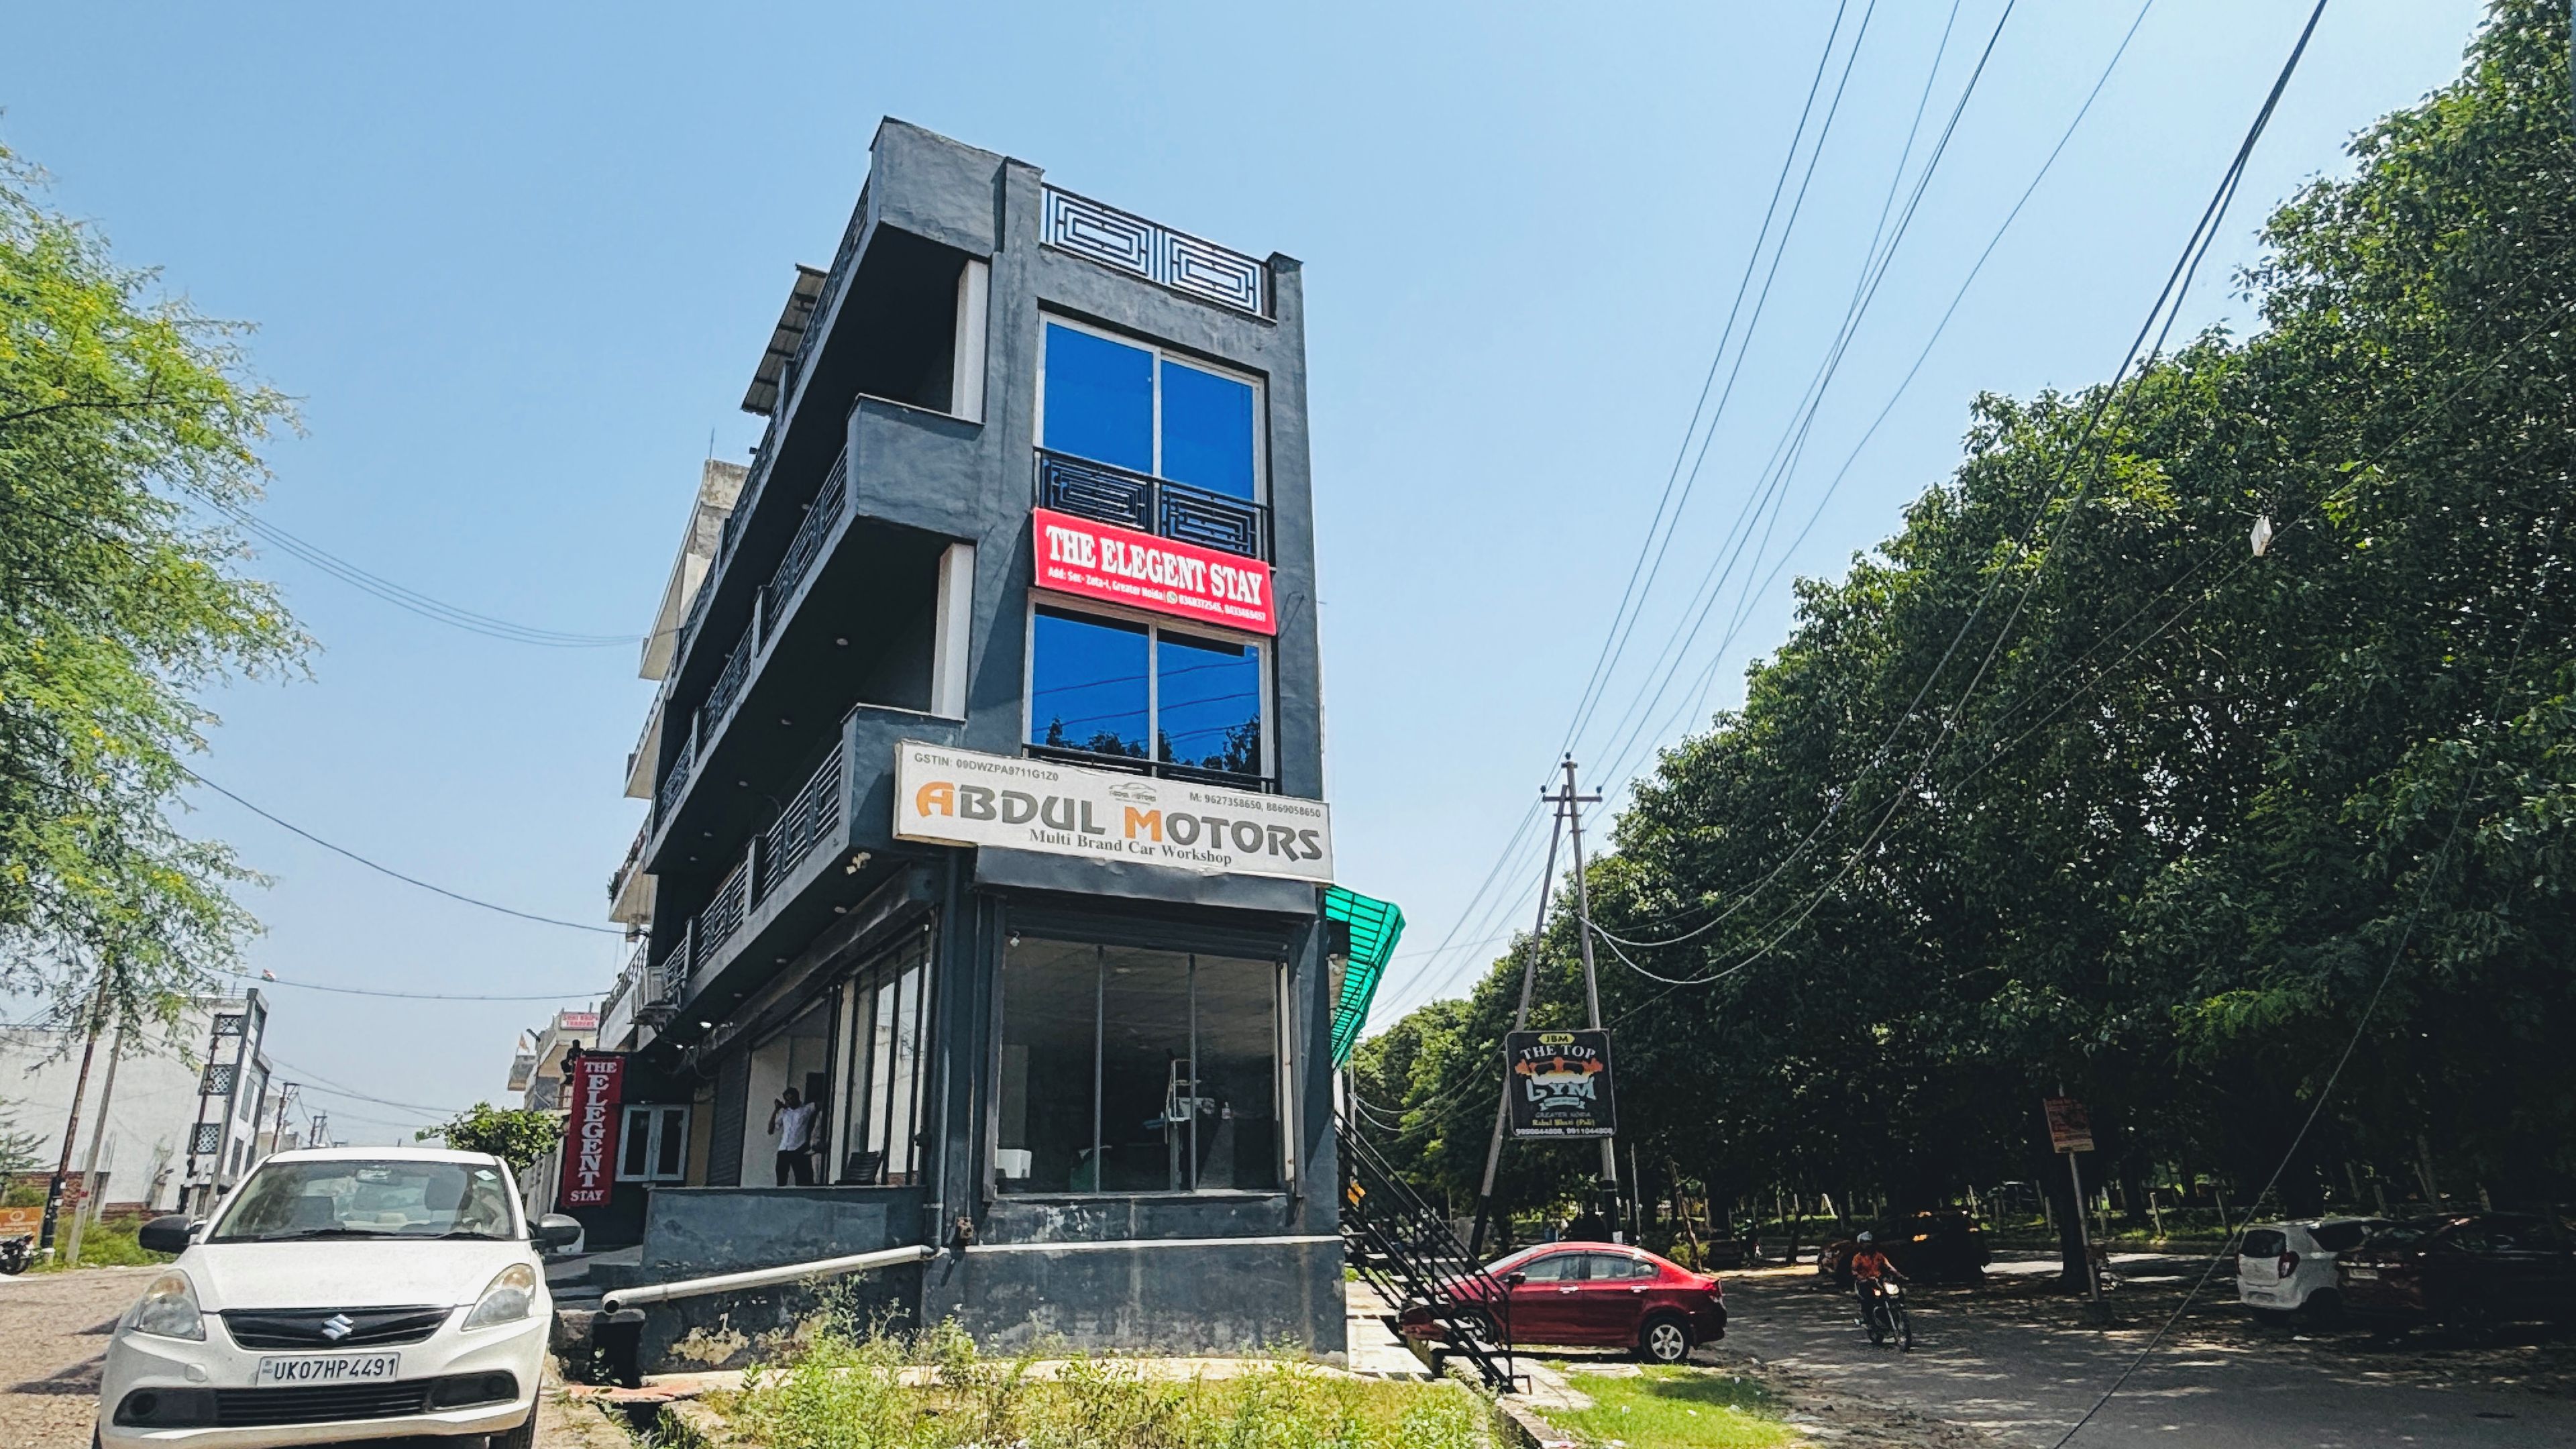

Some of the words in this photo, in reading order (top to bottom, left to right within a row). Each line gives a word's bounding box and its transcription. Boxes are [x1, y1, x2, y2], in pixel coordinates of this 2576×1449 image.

[1045, 525, 1096, 569] THE
[1099, 537, 1207, 594] ELEGENT
[1210, 561, 1263, 606] STAY
[1112, 580, 1140, 595] Greater
[914, 753, 953, 767] GSTIN:
[1189, 792, 1201, 802] M:
[916, 781, 1106, 835] ABDUL
[1124, 806, 1323, 862] MOTORS
[1030, 828, 1071, 846] Multi
[1077, 834, 1122, 853] Brand
[1128, 841, 1156, 856] Car
[1161, 844, 1232, 867] Workshop
[1519, 1045, 1556, 1060] THE
[1560, 1044, 1596, 1059] TOP
[584, 1062, 617, 1073] THE
[1525, 1076, 1597, 1102] GYM
[578, 1075, 610, 1187] ELEGENT
[570, 1190, 604, 1202] STAY
[274, 1358, 396, 1381] UK07HP4491
